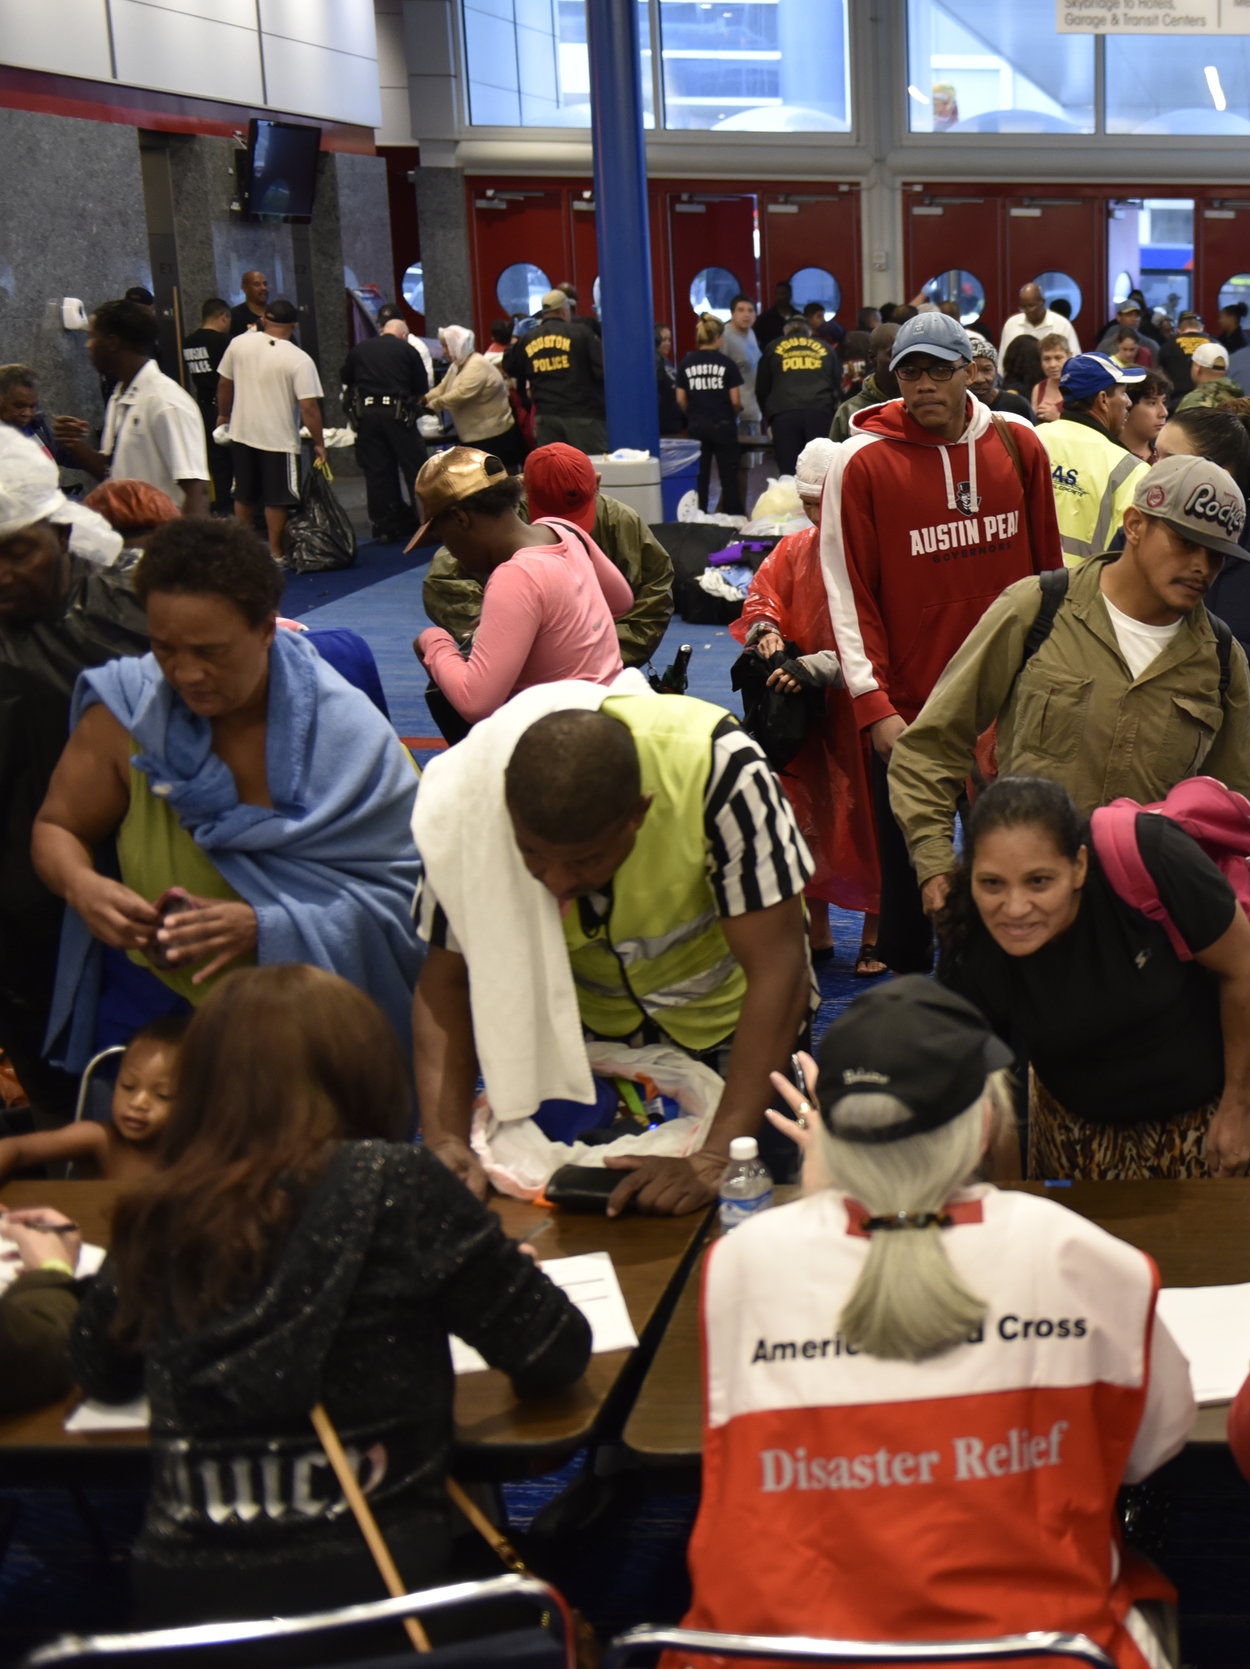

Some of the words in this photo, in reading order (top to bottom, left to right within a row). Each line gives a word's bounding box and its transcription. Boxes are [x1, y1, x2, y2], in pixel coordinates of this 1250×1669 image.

[1064, 12, 1107, 28] Garage
[1111, 13, 1119, 26] &
[1123, 13, 1159, 26] Transit
[1162, 13, 1206, 27] Centers
[525, 334, 571, 358] HOUSTON
[774, 336, 828, 357] HOUSTON
[532, 354, 570, 373] POLICE
[685, 364, 727, 378] HOUSTON
[782, 356, 823, 372] POLICE
[689, 376, 724, 391] POLICE
[909, 518, 980, 556] AUSTIN
[998, 1314, 1087, 1342] Cross
[760, 1446, 940, 1493] Disaster
[953, 1420, 1069, 1482] Relief
